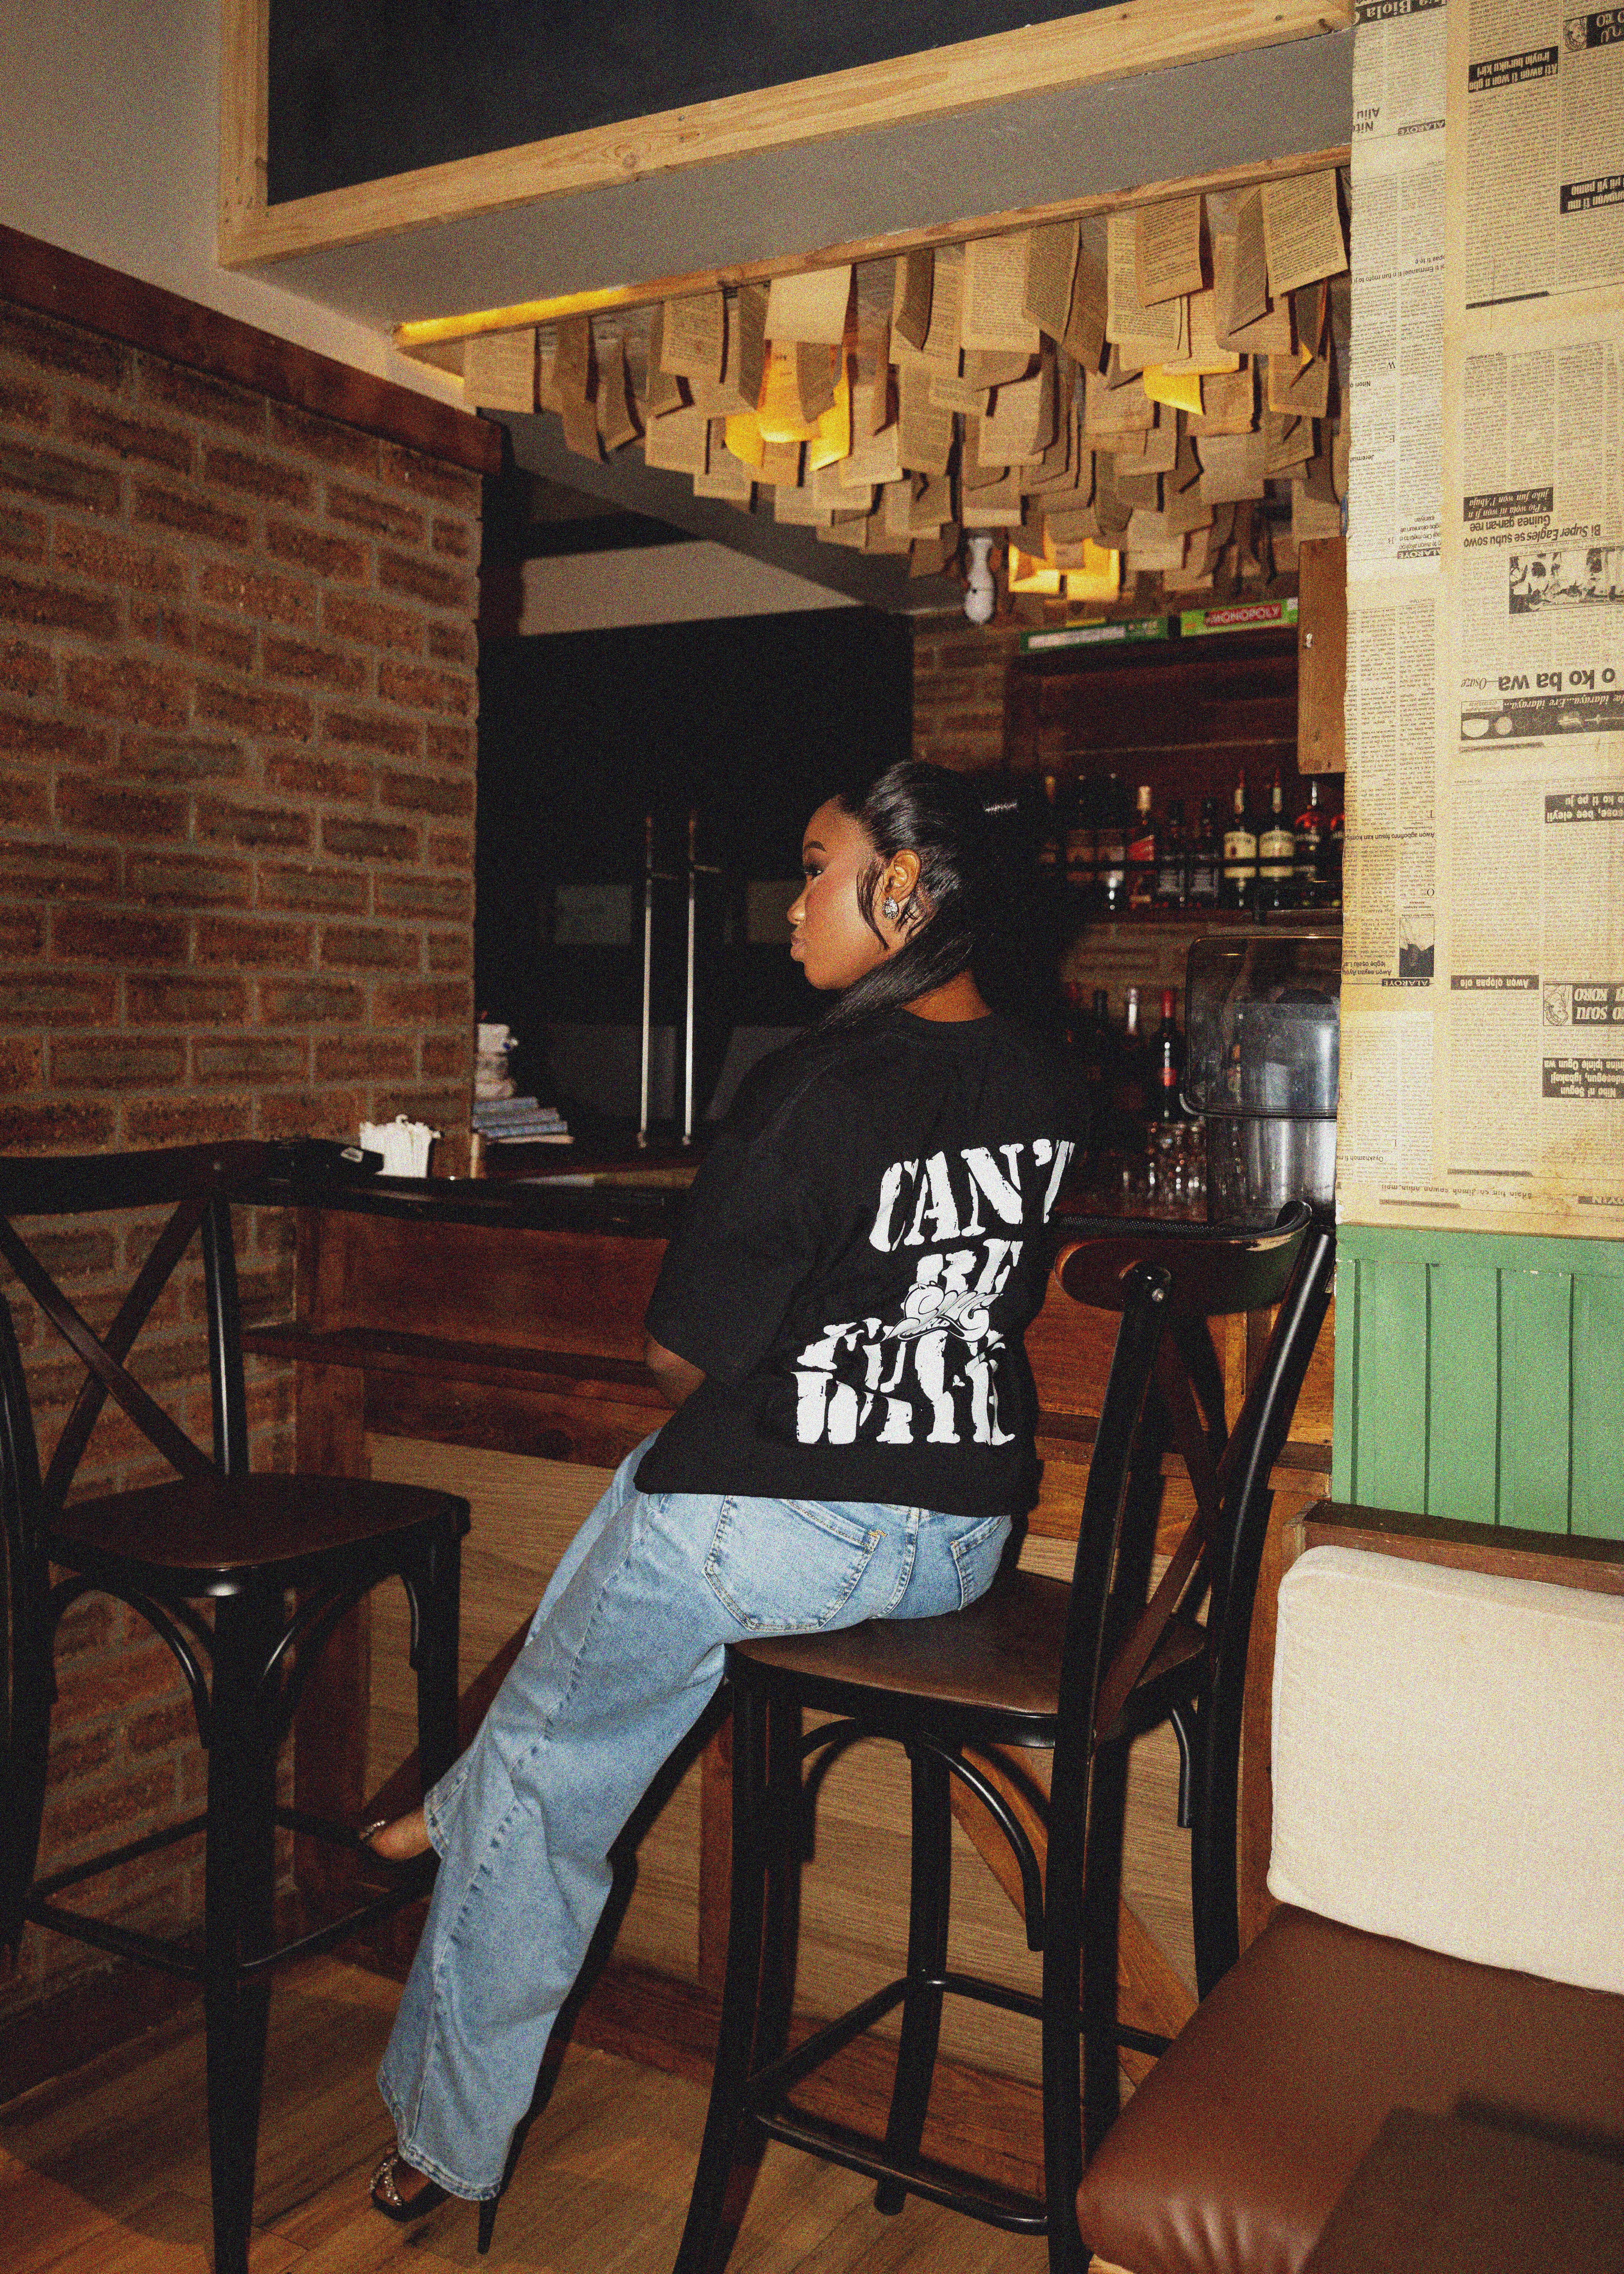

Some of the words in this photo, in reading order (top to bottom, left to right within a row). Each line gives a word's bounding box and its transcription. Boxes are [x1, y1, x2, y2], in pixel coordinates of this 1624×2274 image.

[1517, 515, 1551, 530] Guinea
[1560, 522, 1588, 540] Super
[1591, 524, 1601, 537] Bi
[1527, 526, 1559, 544] Eagles
[1209, 604, 1280, 626] MONOPOLY
[1536, 672, 1562, 693] ba
[1569, 669, 1595, 691] ko
[1574, 988, 1609, 1001] KORO
